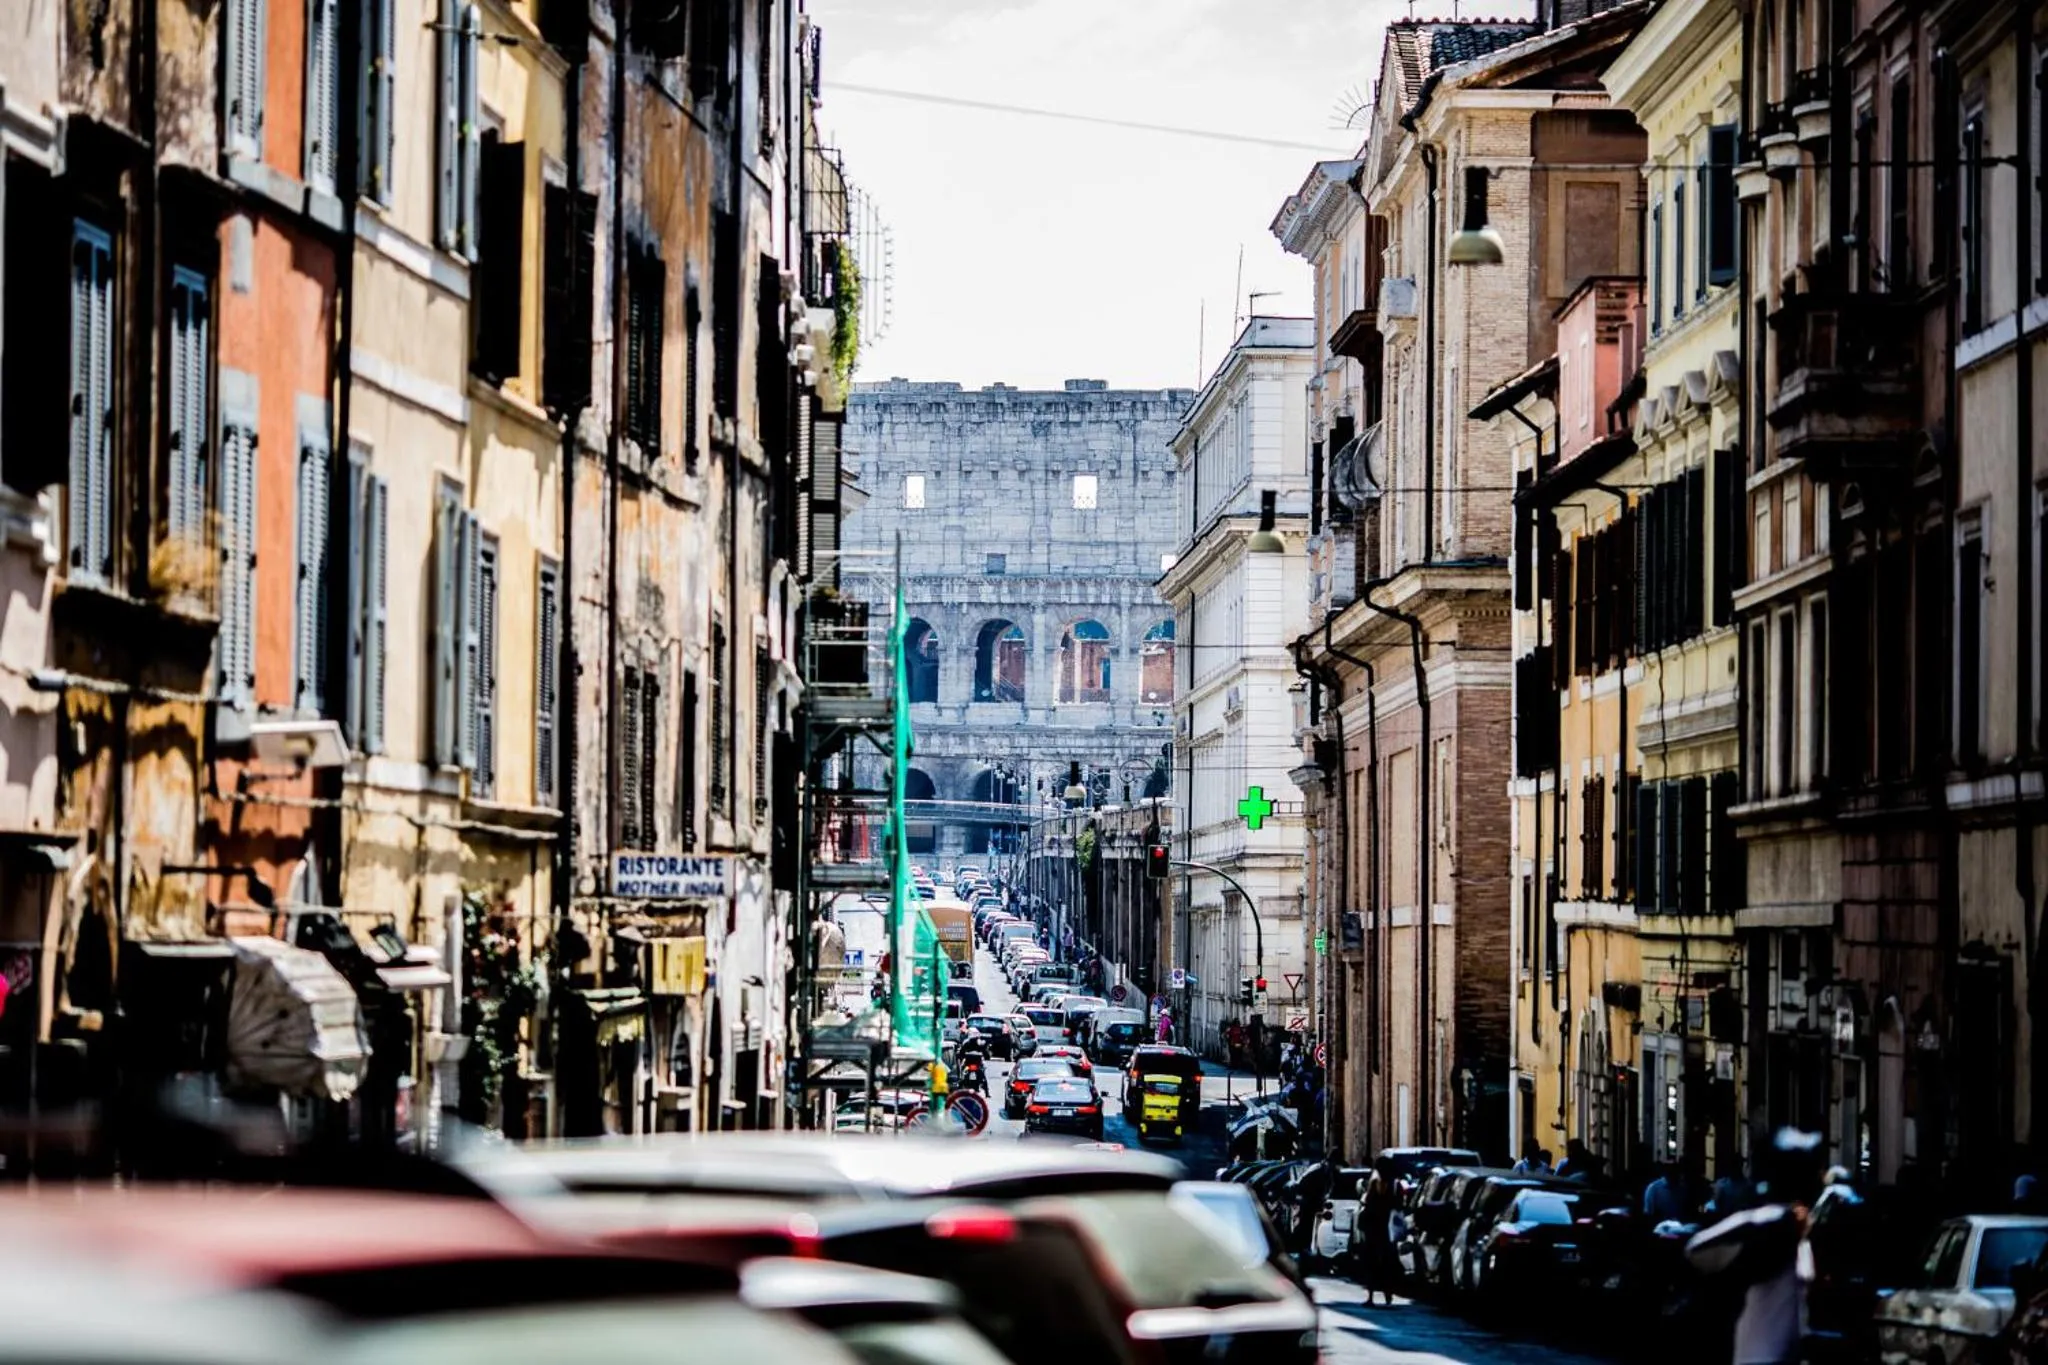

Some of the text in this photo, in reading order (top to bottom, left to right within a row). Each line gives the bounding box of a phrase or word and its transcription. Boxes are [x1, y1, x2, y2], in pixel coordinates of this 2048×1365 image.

[618, 856, 723, 876] RISTORANTE
[618, 881, 724, 895] MOTHER INDIA
